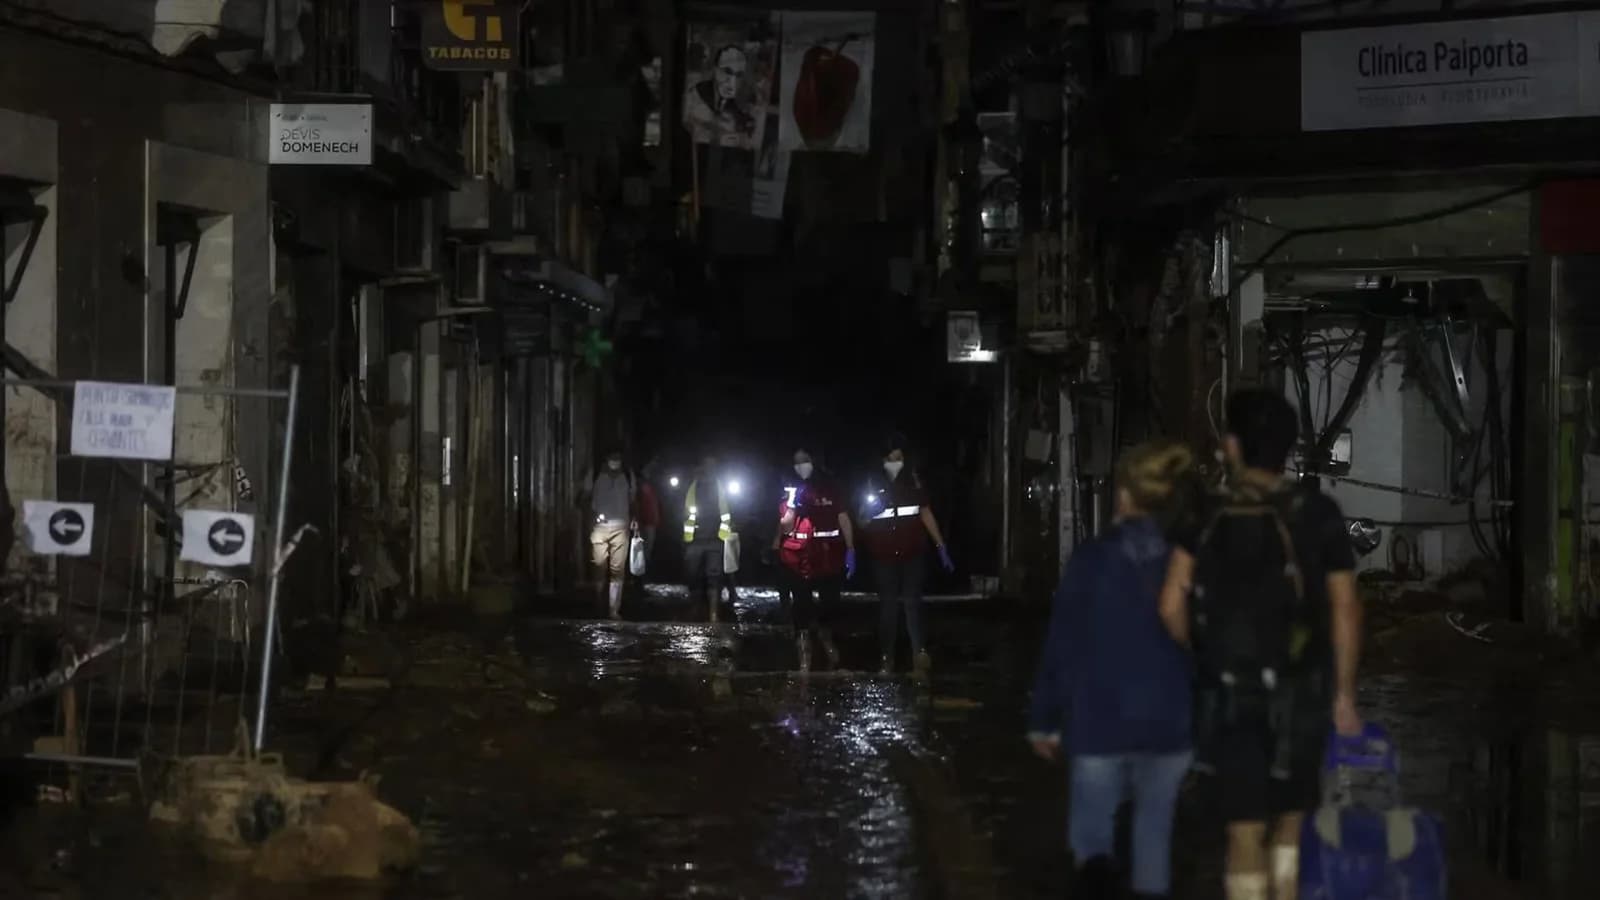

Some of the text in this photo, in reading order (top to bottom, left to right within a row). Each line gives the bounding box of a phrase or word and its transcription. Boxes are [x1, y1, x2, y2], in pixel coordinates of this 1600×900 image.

[428, 47, 512, 60] TABACOS
[1434, 37, 1529, 77] Paiporta
[280, 128, 320, 140] DEVIS
[282, 142, 359, 153] DOMENECH
